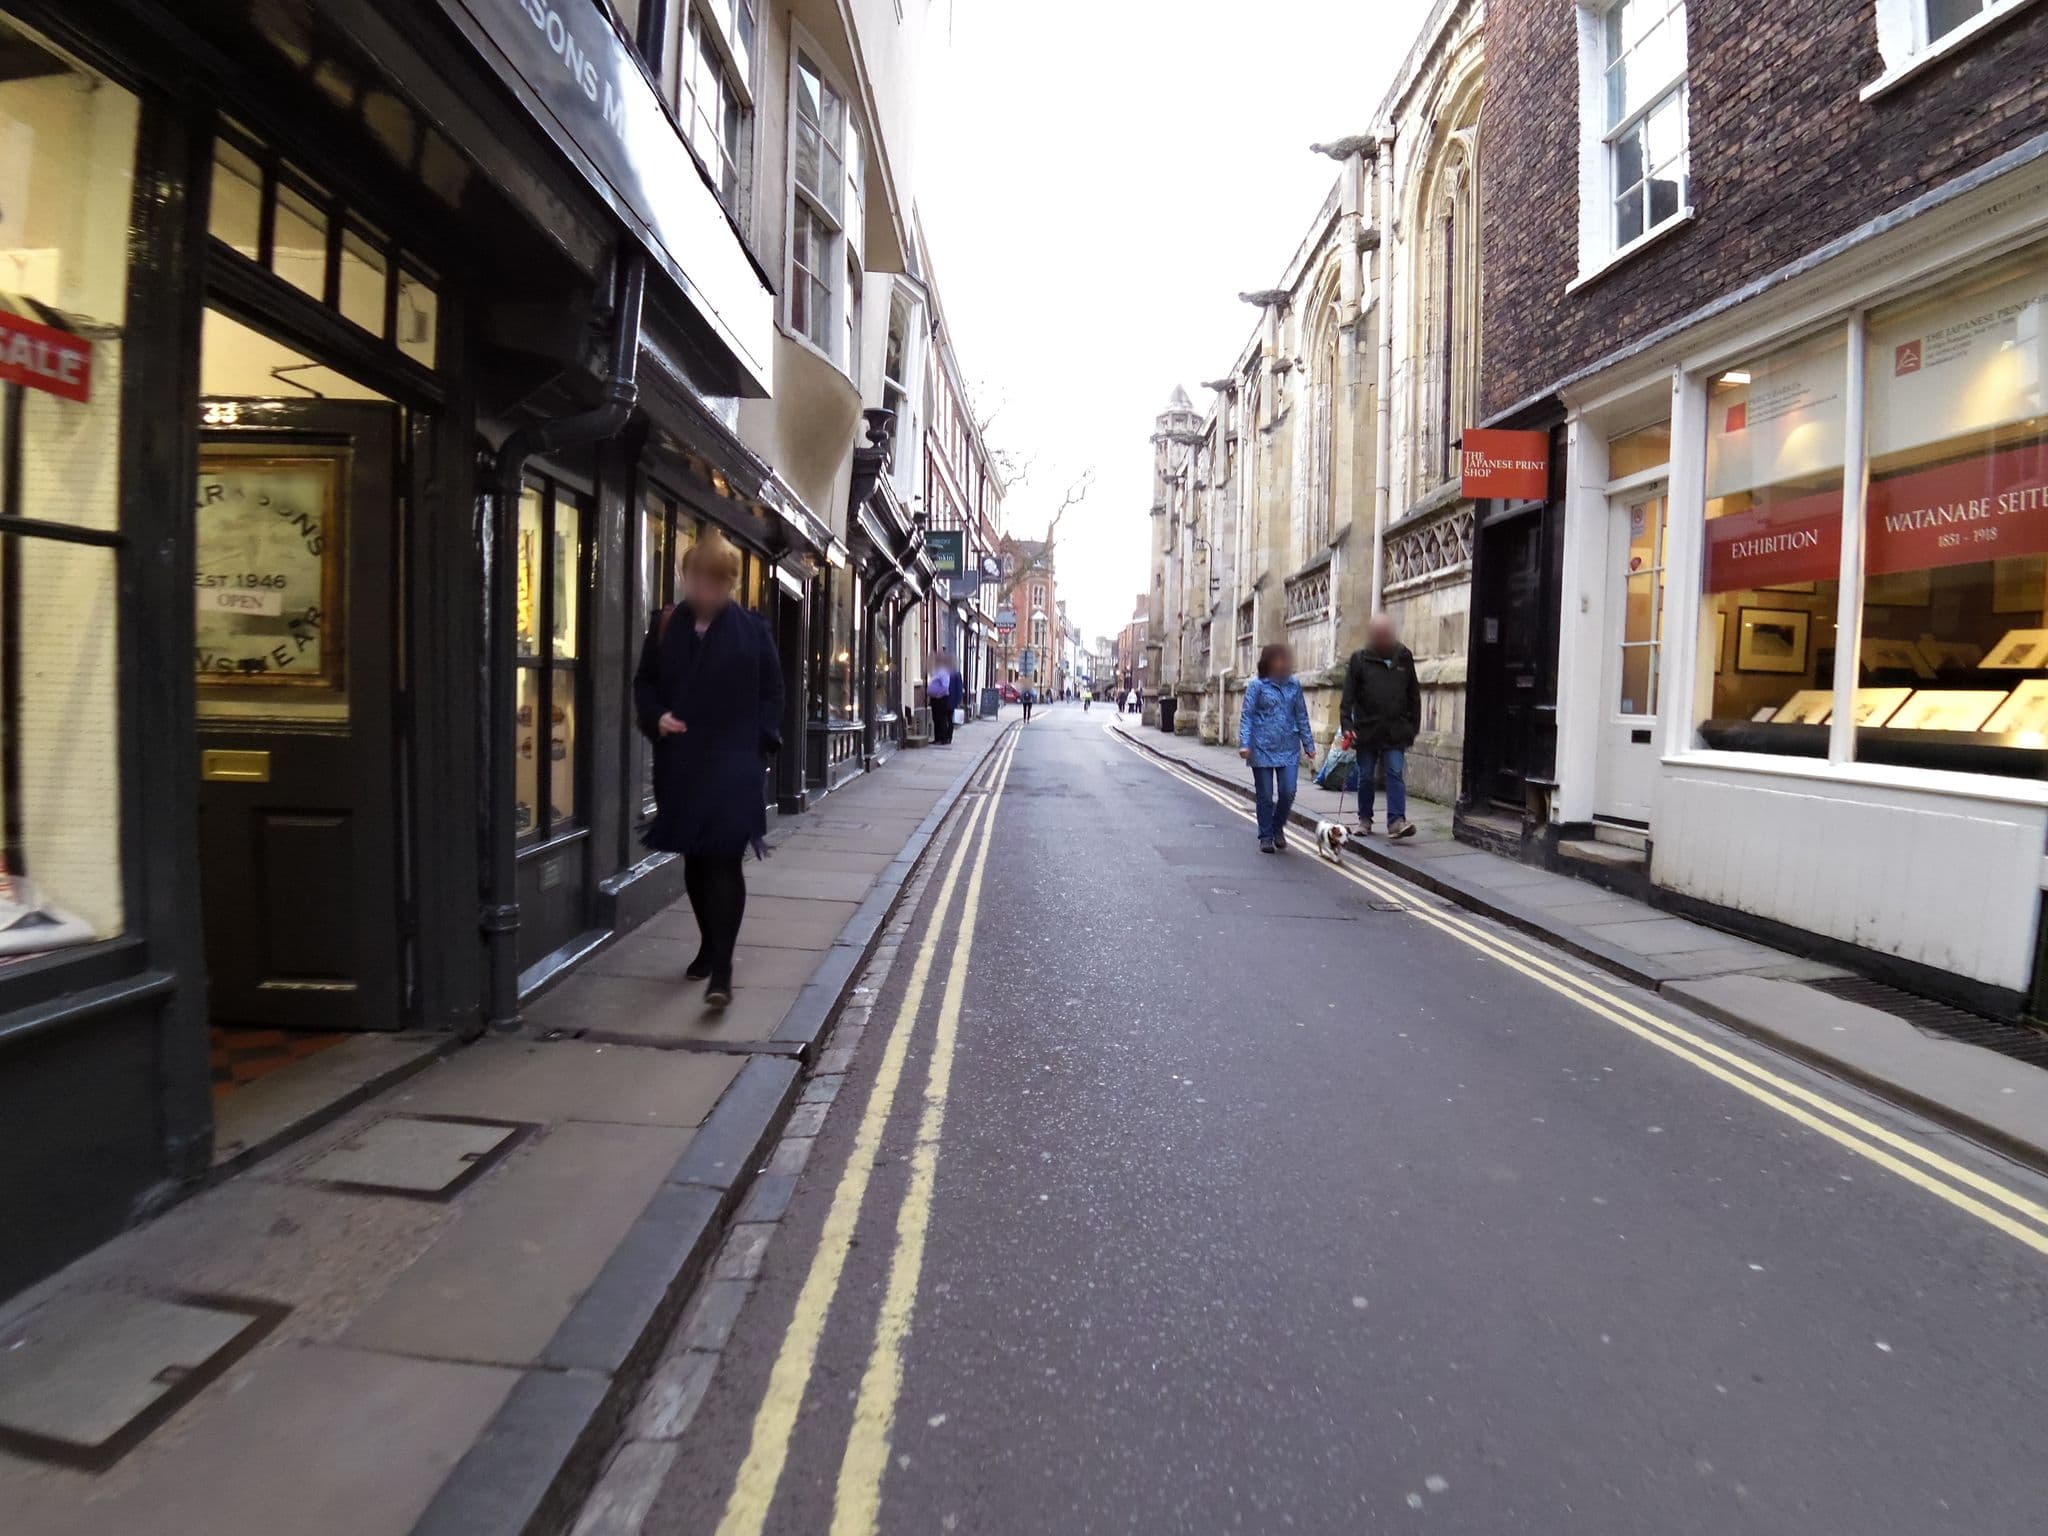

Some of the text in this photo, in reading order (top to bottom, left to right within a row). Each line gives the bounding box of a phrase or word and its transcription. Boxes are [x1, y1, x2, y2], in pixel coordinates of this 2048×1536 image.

[520, 0, 598, 102] SONS
[1464, 451, 1484, 460] THE
[1463, 468, 1492, 477] SHOP
[1465, 460, 1546, 470] JAPANESE PRINT
[1885, 497, 1990, 533] WATANABE
[1731, 529, 1819, 559] EXHIBITION
[235, 573, 287, 589] 1946
[217, 593, 264, 608] OPEN
